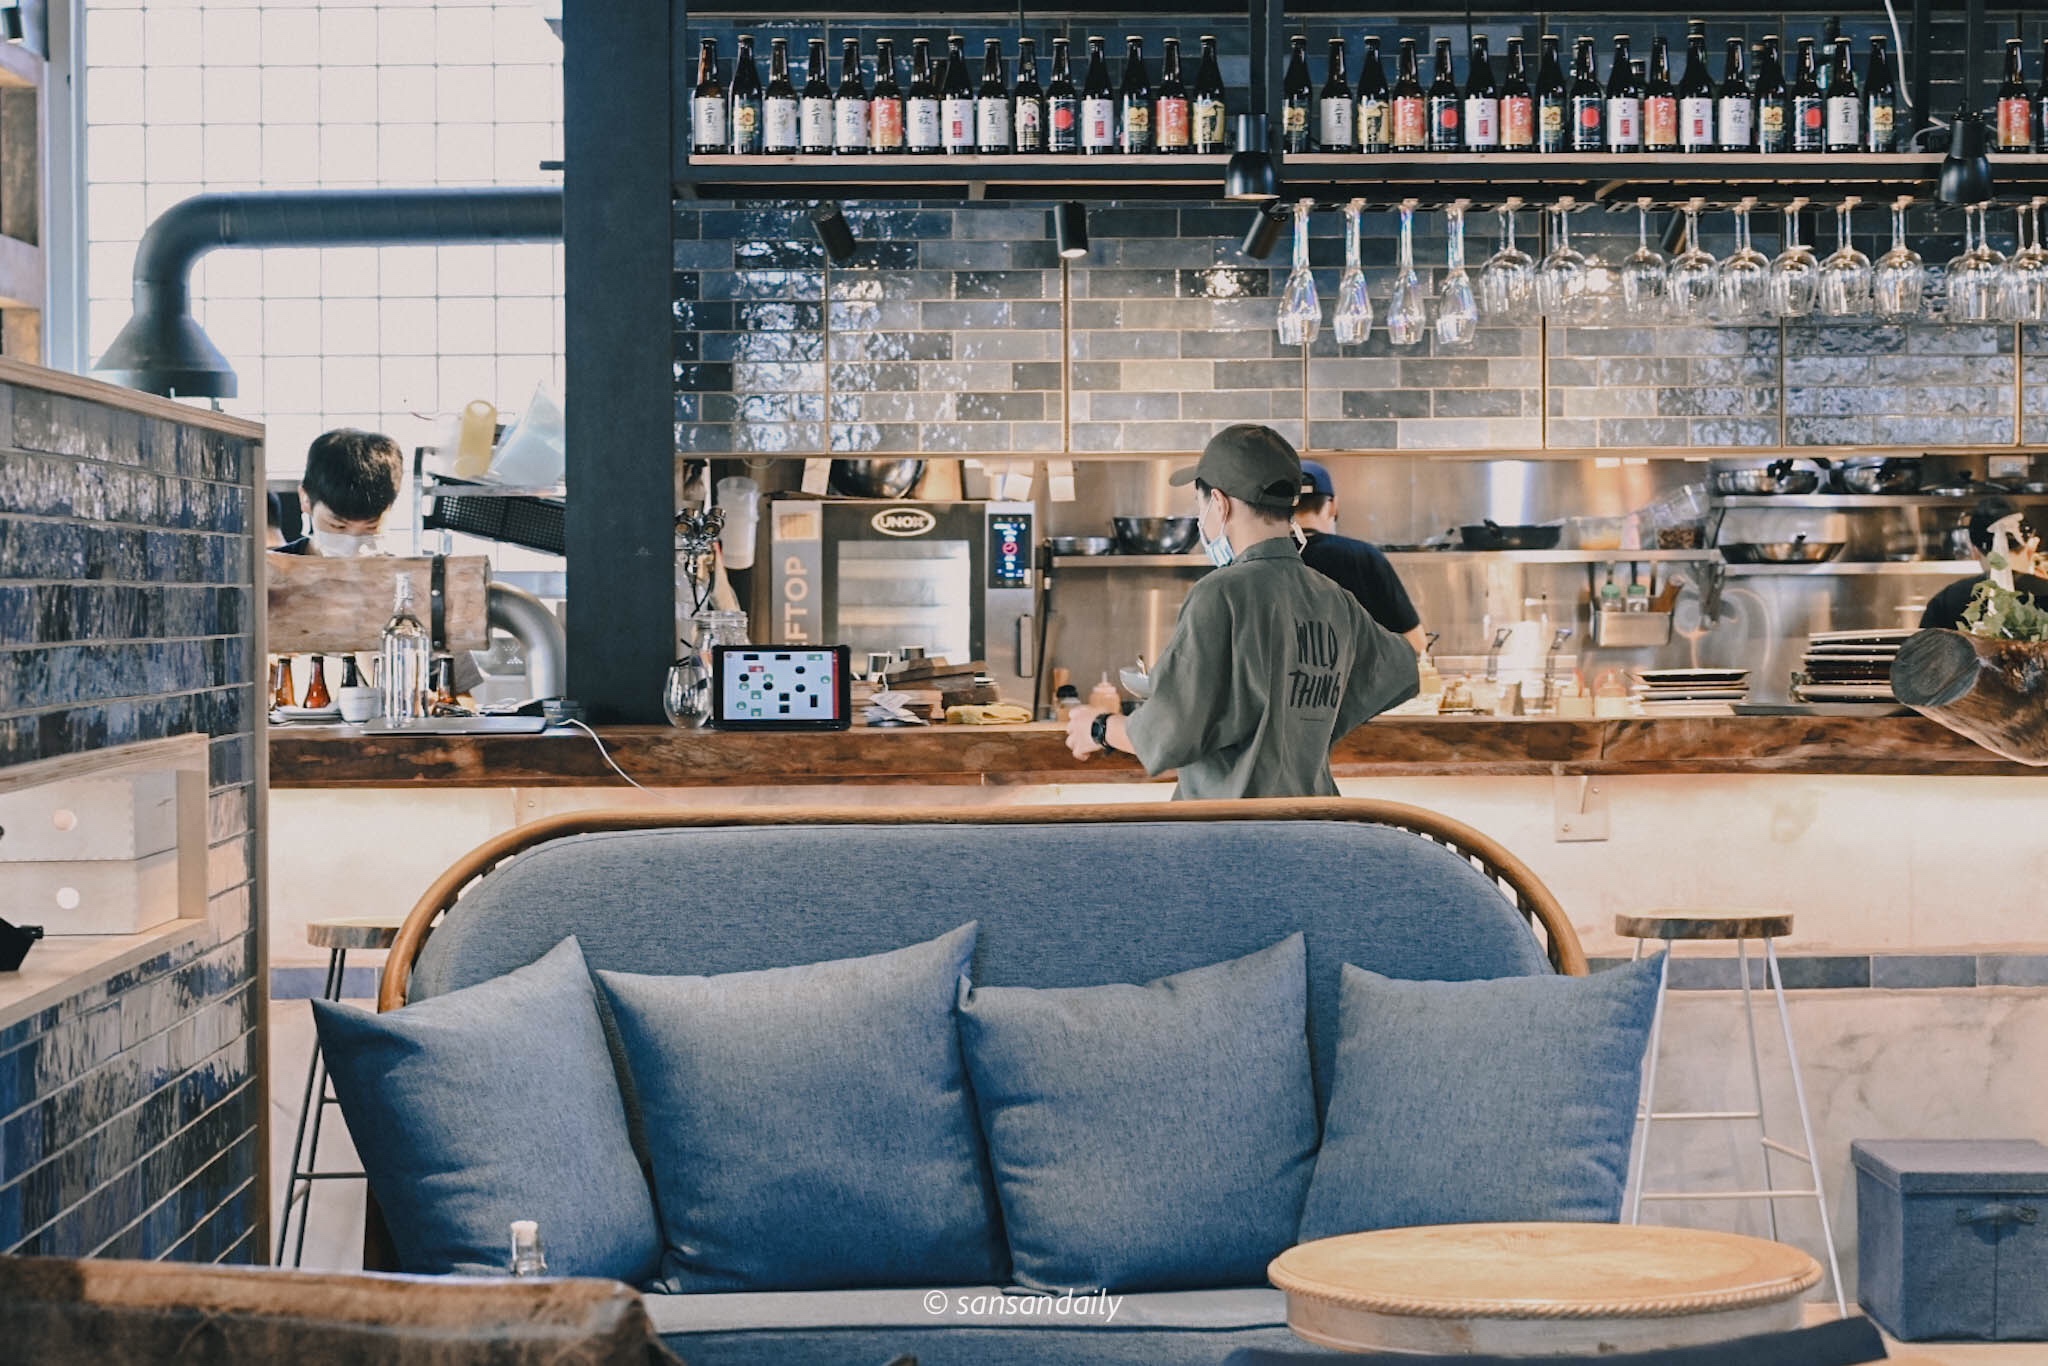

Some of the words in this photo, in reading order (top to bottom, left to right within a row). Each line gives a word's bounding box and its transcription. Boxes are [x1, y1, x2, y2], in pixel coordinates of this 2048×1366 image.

[880, 515, 926, 528] UNOX
[784, 556, 808, 645] FTOP
[1294, 617, 1339, 671] WILD
[1287, 669, 1341, 709] THING
